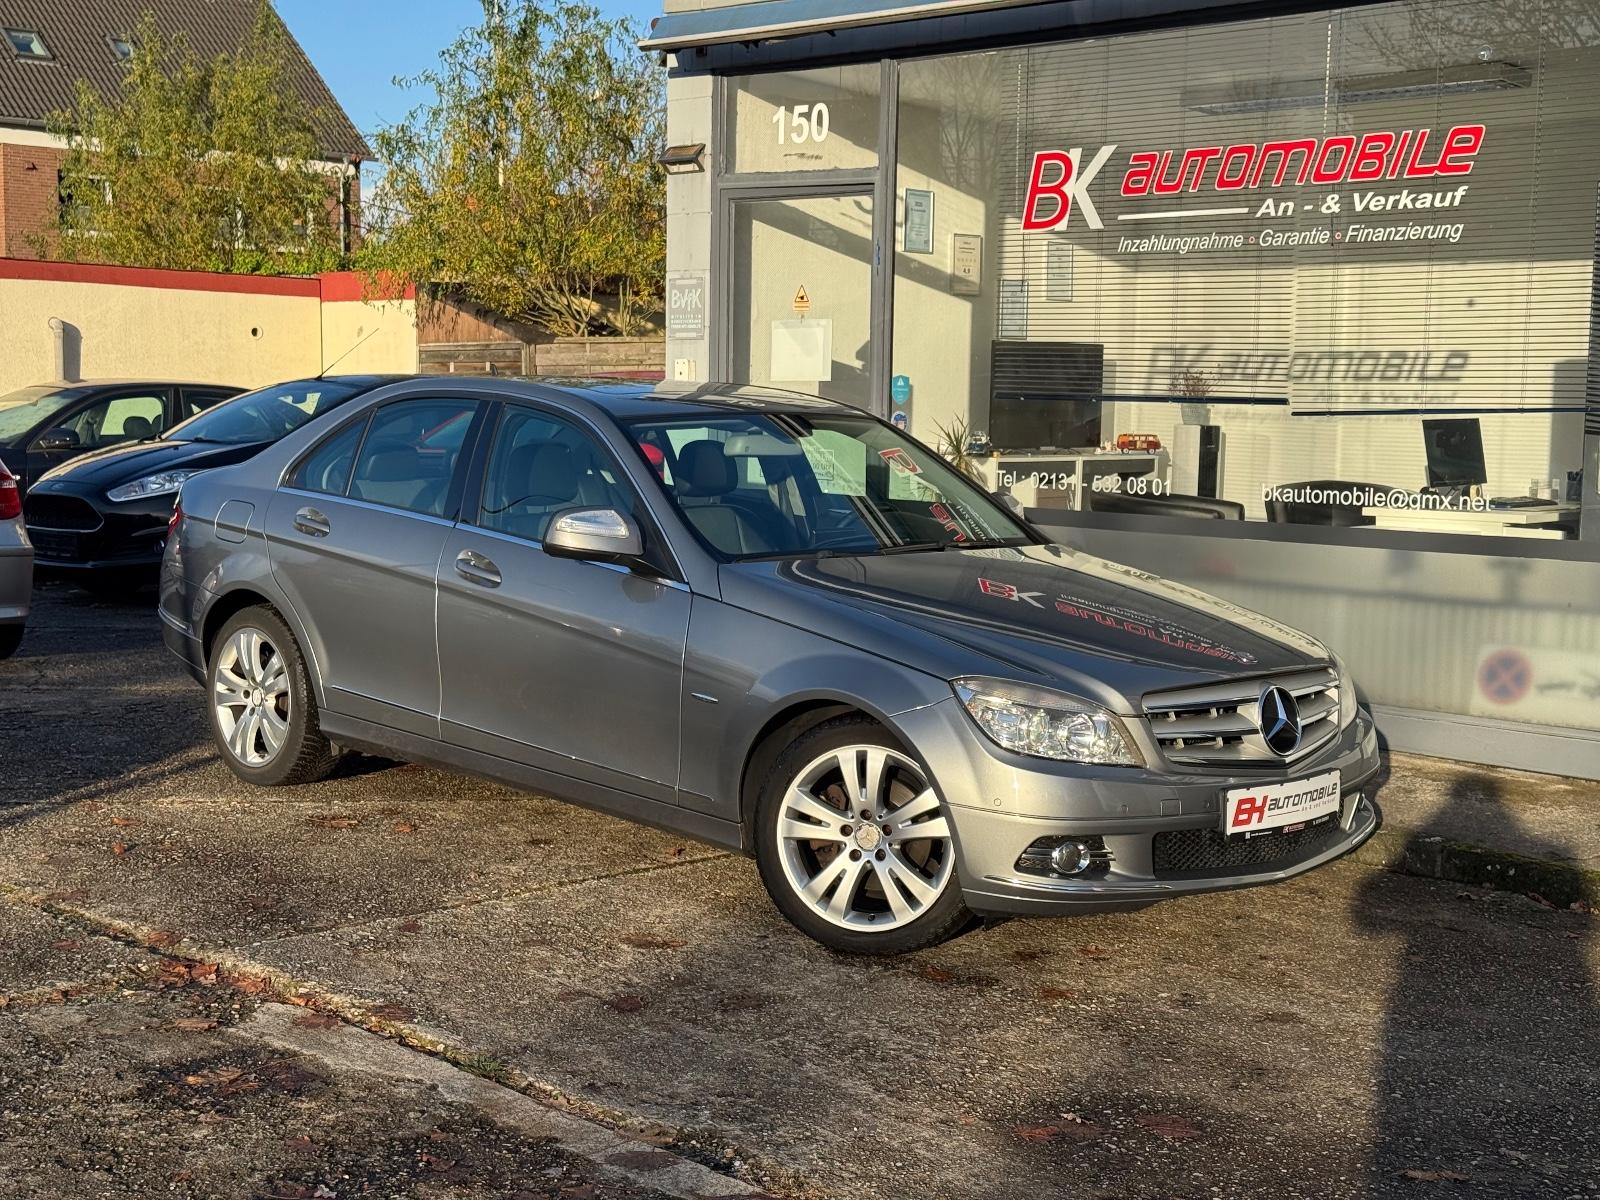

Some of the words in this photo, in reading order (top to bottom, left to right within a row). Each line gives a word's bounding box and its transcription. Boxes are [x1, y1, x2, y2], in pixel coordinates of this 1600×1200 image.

[773, 103, 829, 145] 150
[1021, 144, 1118, 232] BK
[1255, 198, 1295, 217] An
[1321, 193, 1341, 214] &
[1353, 186, 1468, 212] Verkauf
[1118, 232, 1243, 254] Inzahlungnahme
[1259, 226, 1330, 246] Garantie
[1345, 222, 1464, 243] Finanzierung
[1031, 471, 1076, 491] 02131
[1092, 474, 1122, 494] 532
[1127, 476, 1147, 496] 08
[1152, 478, 1171, 497] 01
[1262, 483, 1492, 512] bkautomobile@gmx.net
